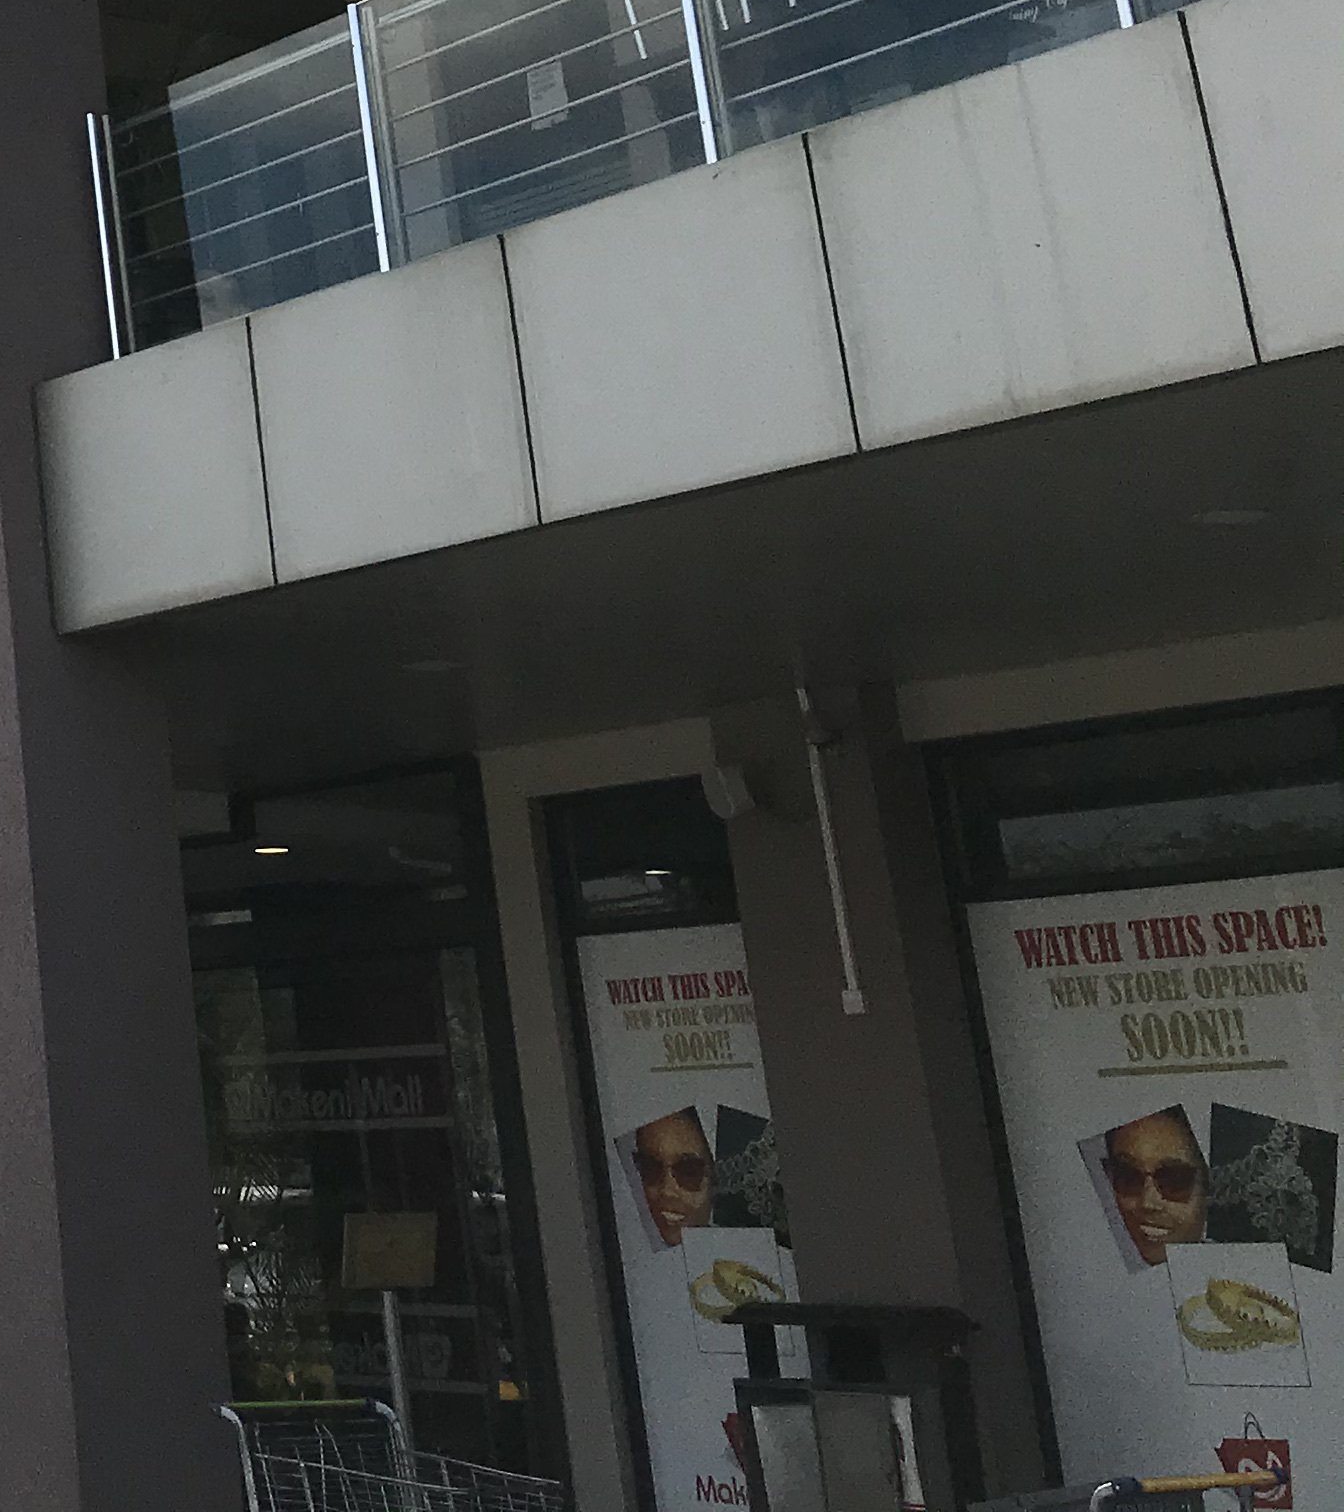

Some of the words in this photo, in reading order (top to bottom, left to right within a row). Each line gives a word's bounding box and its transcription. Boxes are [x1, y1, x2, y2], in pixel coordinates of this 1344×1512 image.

[1014, 921, 1124, 969] WATCH
[1127, 914, 1208, 960] THIS
[1212, 904, 1328, 955] SPACE!
[606, 975, 665, 1005] WATCH
[668, 972, 711, 1001] THIS
[714, 969, 750, 998] SPA
[1047, 974, 1100, 1010] NEW
[1104, 969, 1189, 1006] STORE
[1192, 961, 1309, 1000] OPENING
[656, 1006, 701, 1028] STORE
[702, 1003, 754, 1026] OPENIN
[663, 1030, 734, 1064] SOON!!
[1120, 1008, 1250, 1062] SOON!!
[696, 1474, 747, 1505] Mak
